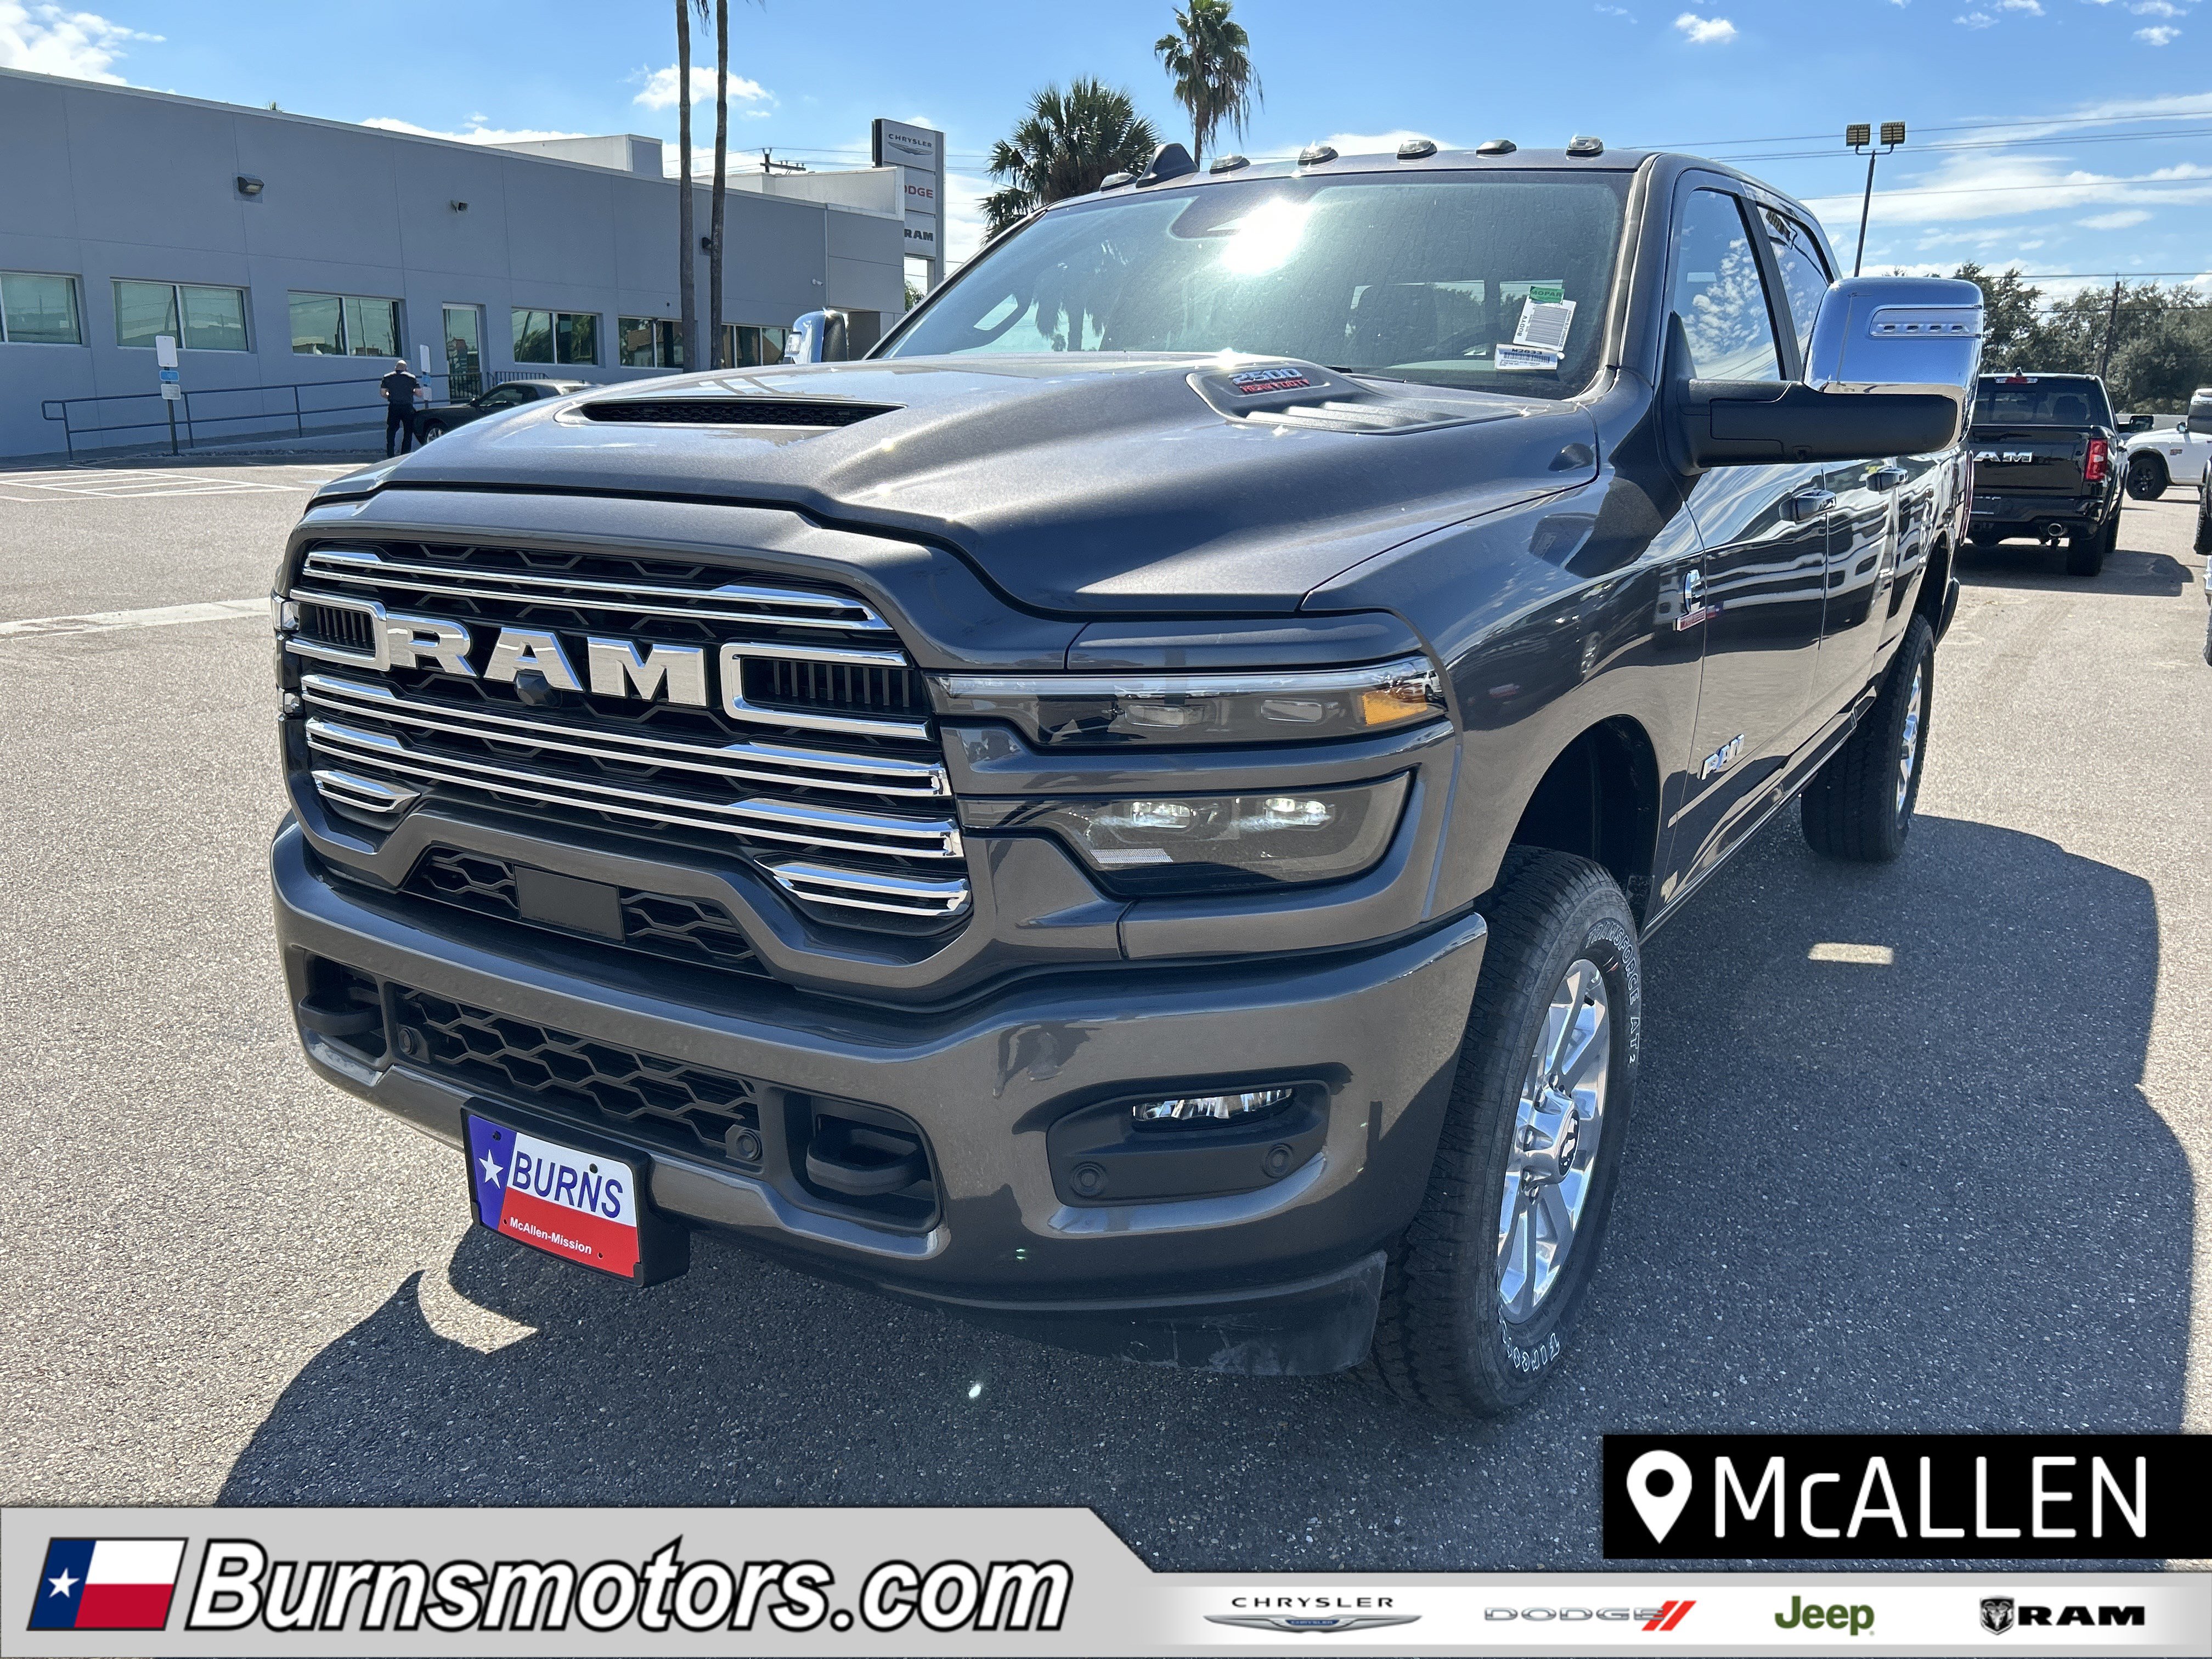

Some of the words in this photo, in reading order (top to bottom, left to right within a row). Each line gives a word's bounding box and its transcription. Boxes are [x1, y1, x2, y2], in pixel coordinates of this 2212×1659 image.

[888, 133, 932, 148] CHRYSLER
[905, 185, 933, 198] DGE
[904, 229, 933, 241] RAM
[1228, 368, 1303, 385] 2500
[1240, 382, 1280, 394] HEAVY
[1280, 379, 1310, 389] DUTY
[1973, 451, 2033, 462] AM
[385, 612, 707, 707] RAM
[1585, 920, 1640, 1006] TRANSFORCE
[1630, 1017, 1640, 1050] AT
[512, 1150, 623, 1218] BURNS
[510, 1216, 592, 1255] McAllen-Mission
